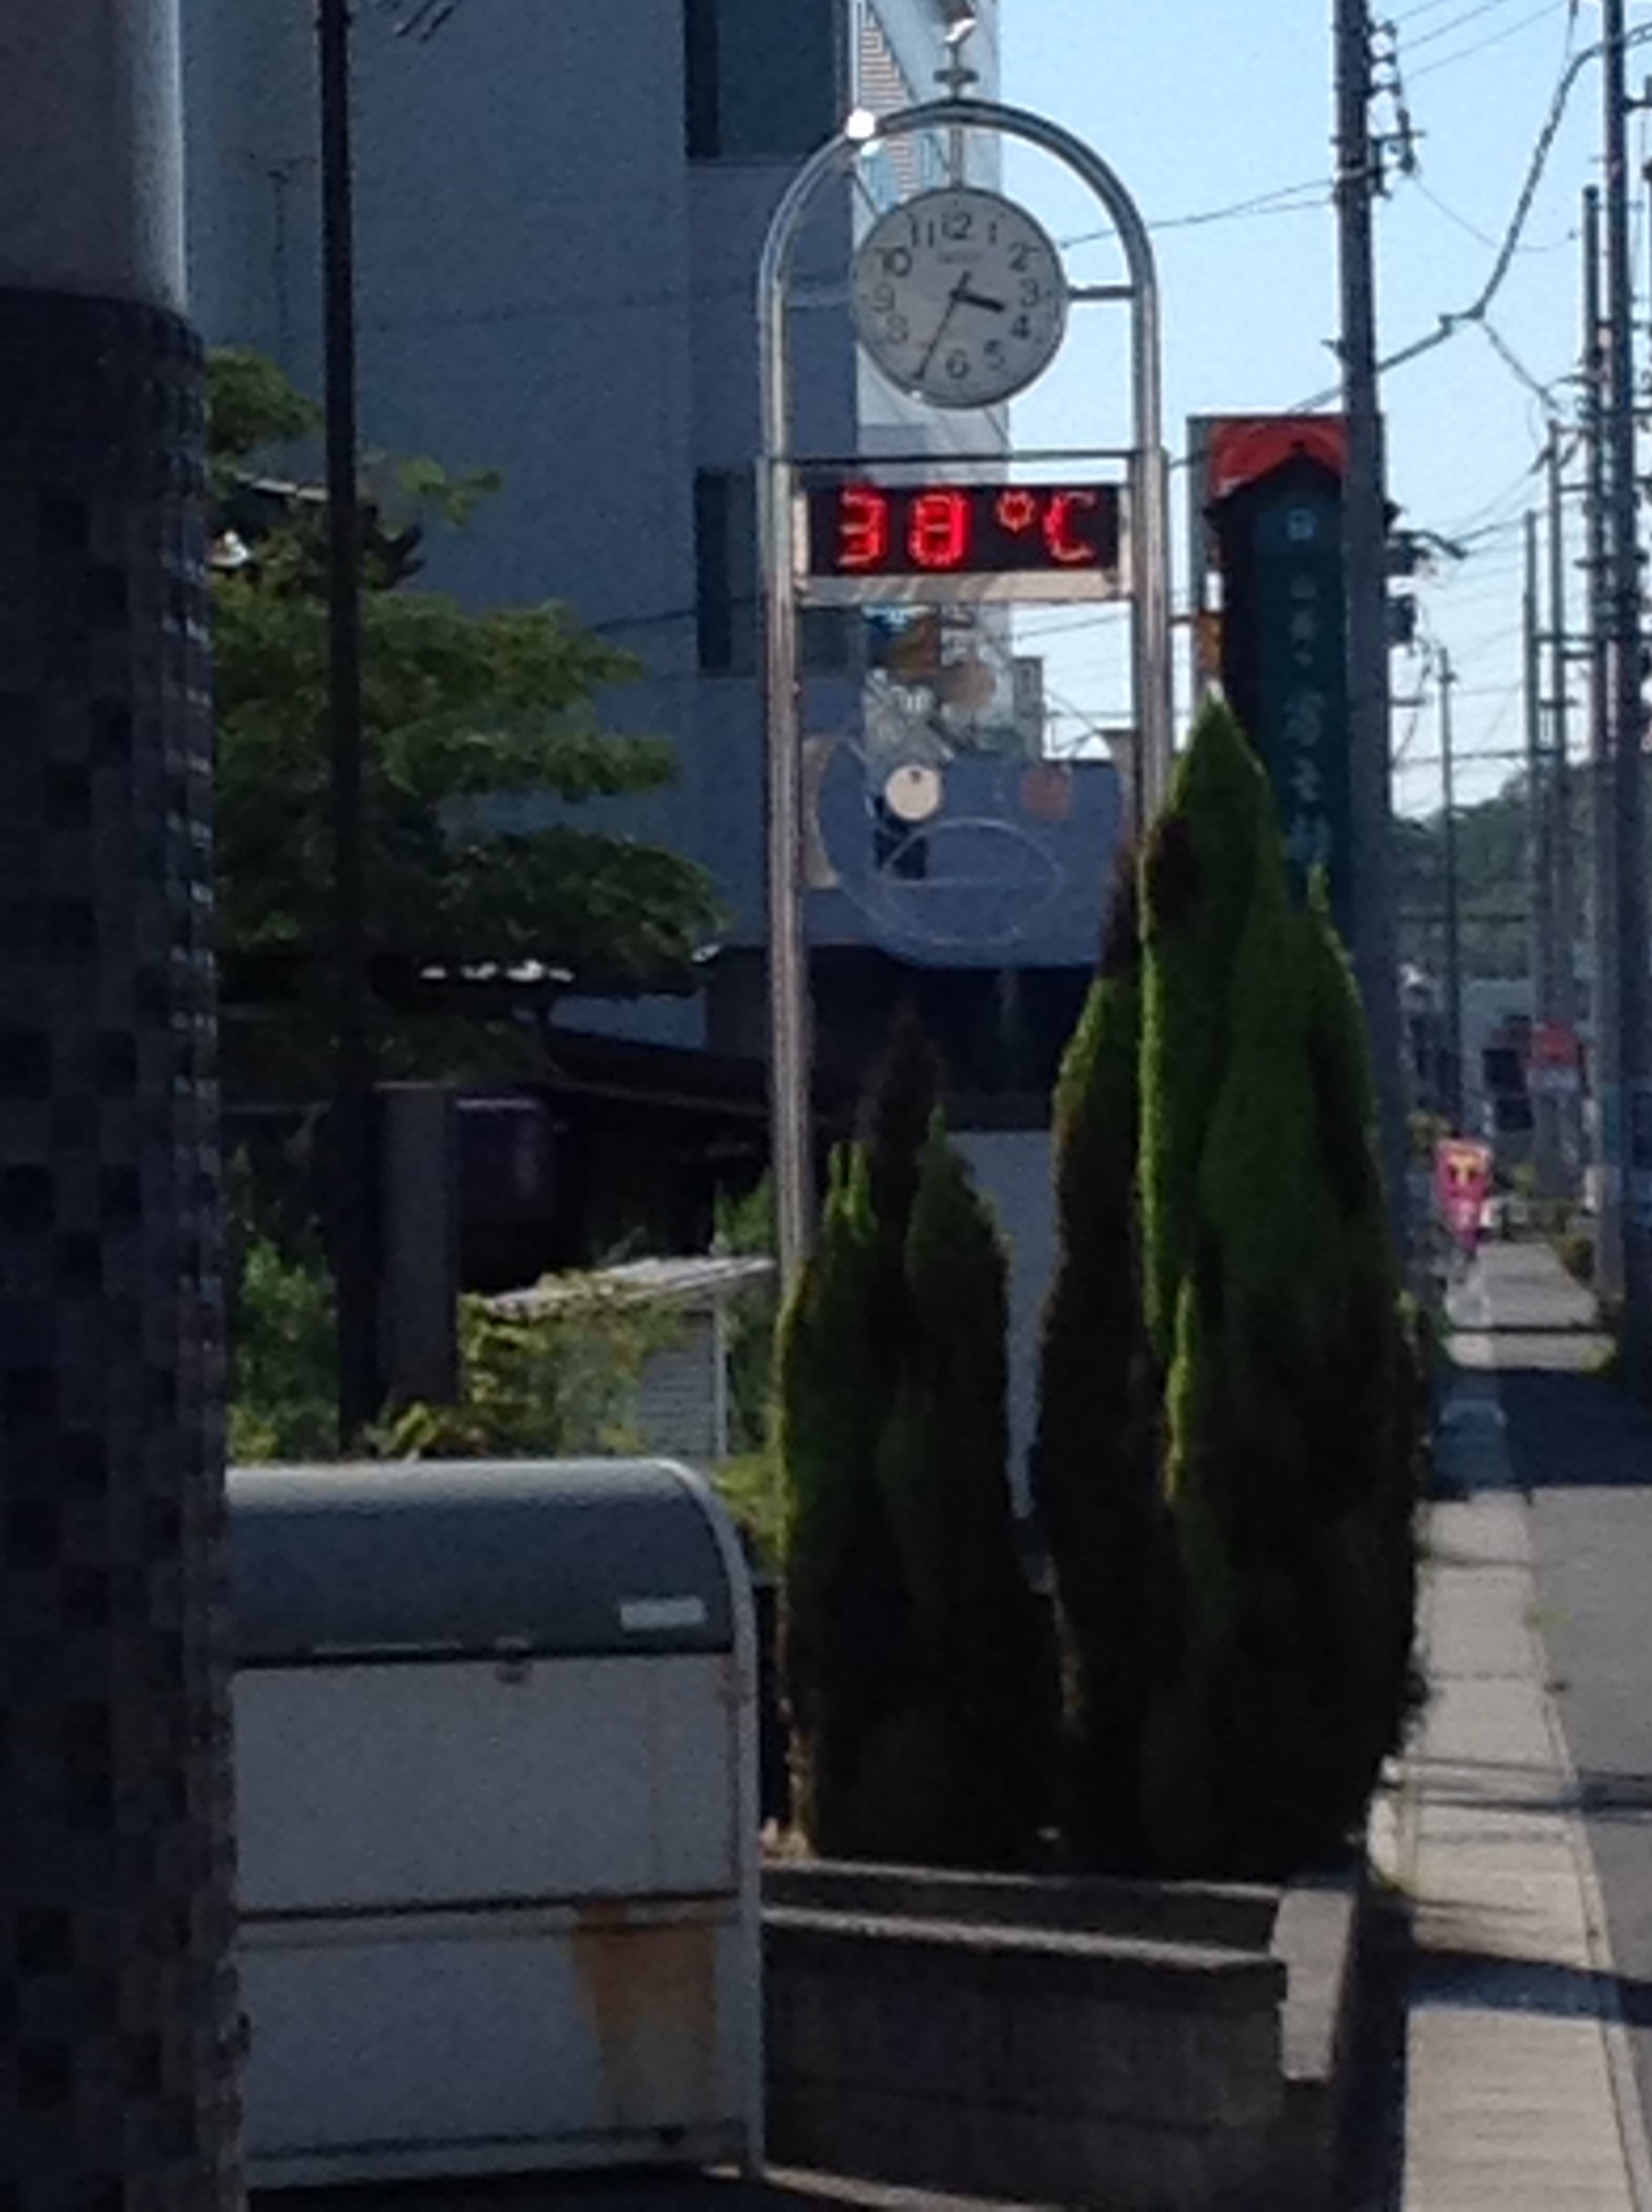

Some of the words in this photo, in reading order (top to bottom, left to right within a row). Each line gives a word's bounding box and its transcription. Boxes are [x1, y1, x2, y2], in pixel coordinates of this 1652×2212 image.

[940, 212, 972, 241] 12
[988, 221, 997, 246] 1
[874, 246, 912, 278] 10
[1009, 240, 1029, 273] 2
[872, 281, 896, 314] 9
[1018, 278, 1040, 309] 3
[886, 314, 910, 346] 8
[1010, 314, 1031, 340] 4
[945, 348, 970, 380] 6
[982, 338, 1005, 371] 5
